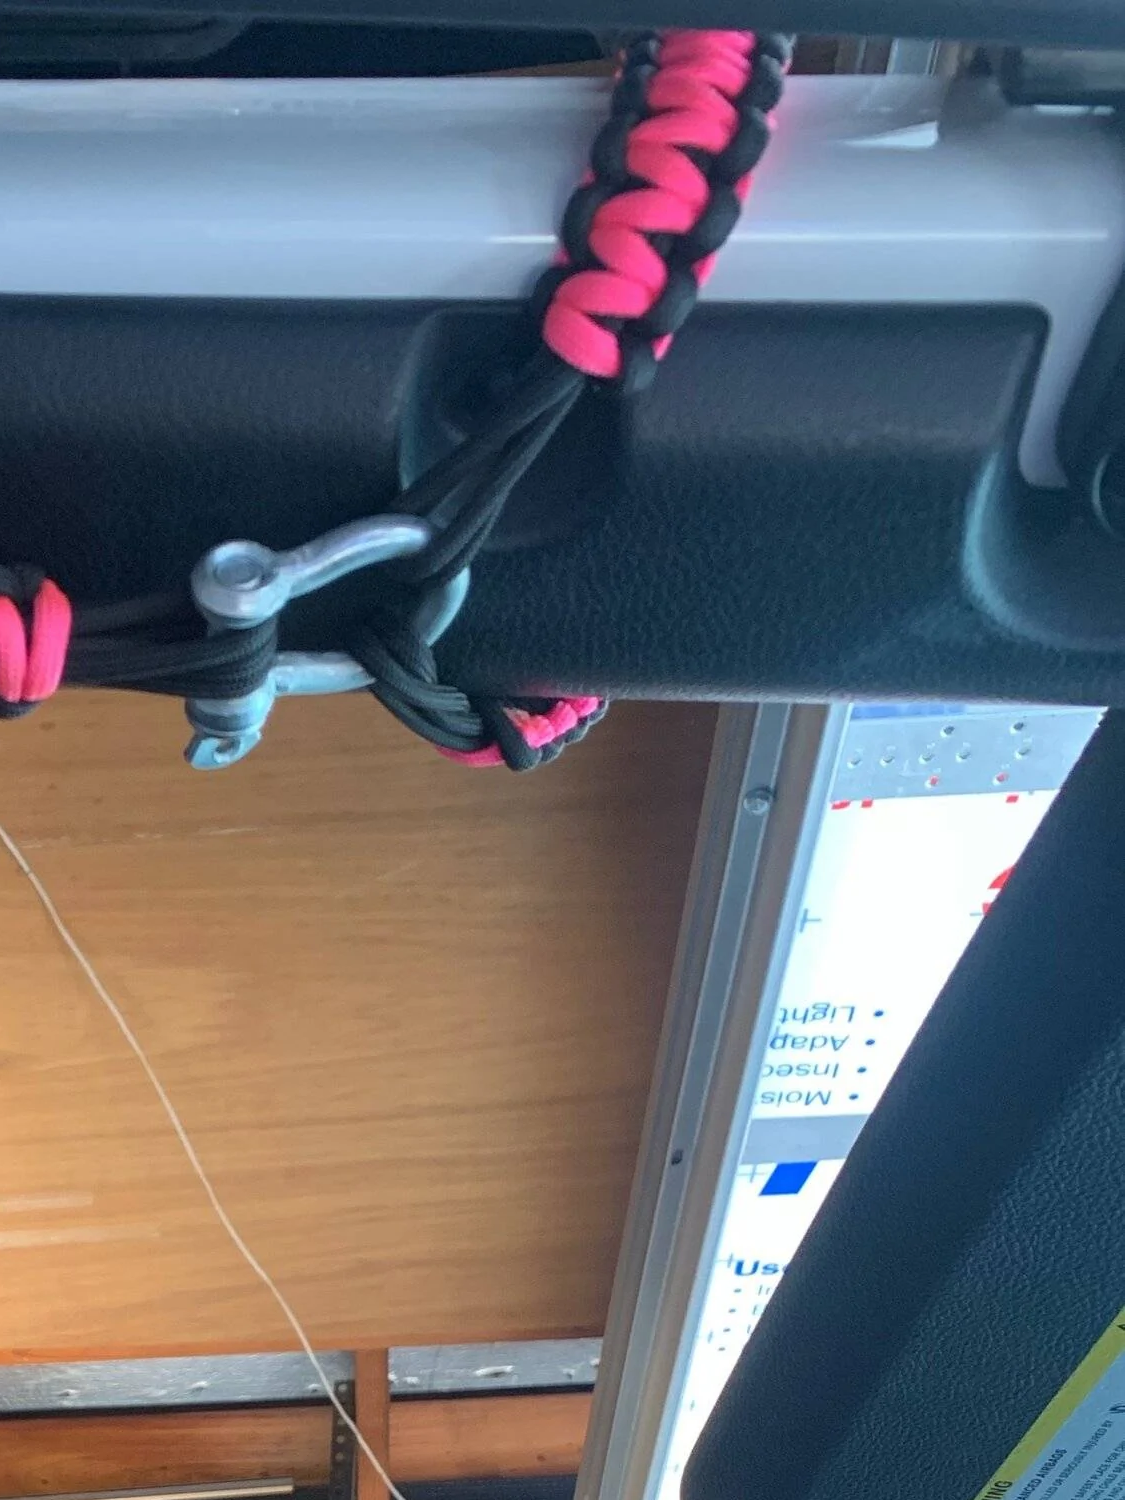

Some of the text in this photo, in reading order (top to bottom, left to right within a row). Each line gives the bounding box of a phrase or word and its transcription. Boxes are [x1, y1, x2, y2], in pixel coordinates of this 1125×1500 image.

[778, 1002, 855, 1024] Light
[759, 1090, 832, 1108] Mois
[1036, 1449, 1067, 1478] AIRBAGS
